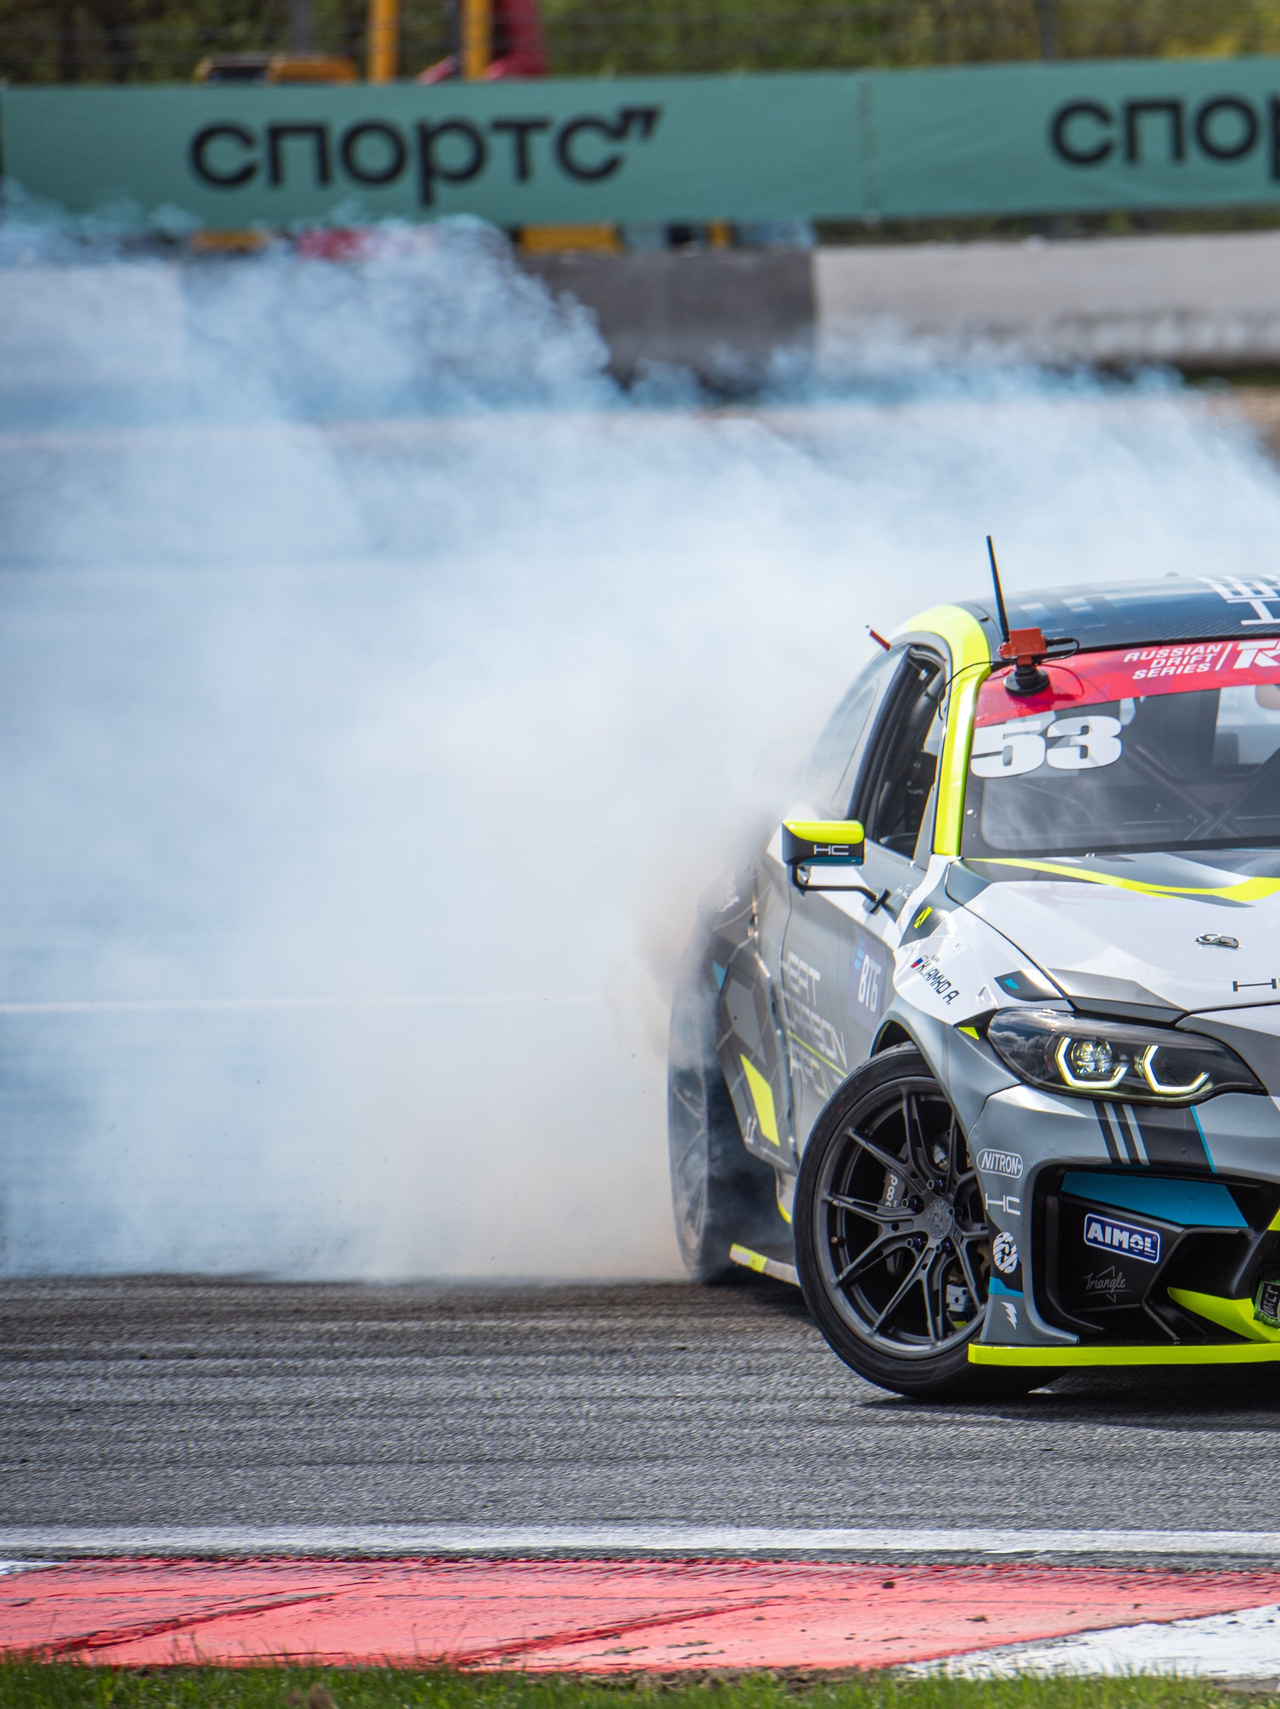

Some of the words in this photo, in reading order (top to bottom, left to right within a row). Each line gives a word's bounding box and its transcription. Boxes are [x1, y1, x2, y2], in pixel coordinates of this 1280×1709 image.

[1124, 643, 1222, 663] RUSSIAN
[1150, 653, 1215, 669] DRIFT
[1132, 662, 1211, 680] SERIES
[970, 715, 1123, 778] 53
[813, 844, 849, 856] HC
[857, 954, 882, 1013] ВТБ
[985, 1193, 1021, 1216] HC
[1087, 1222, 1156, 1257] AIMOL
[1083, 1272, 1127, 1294] Triangle
